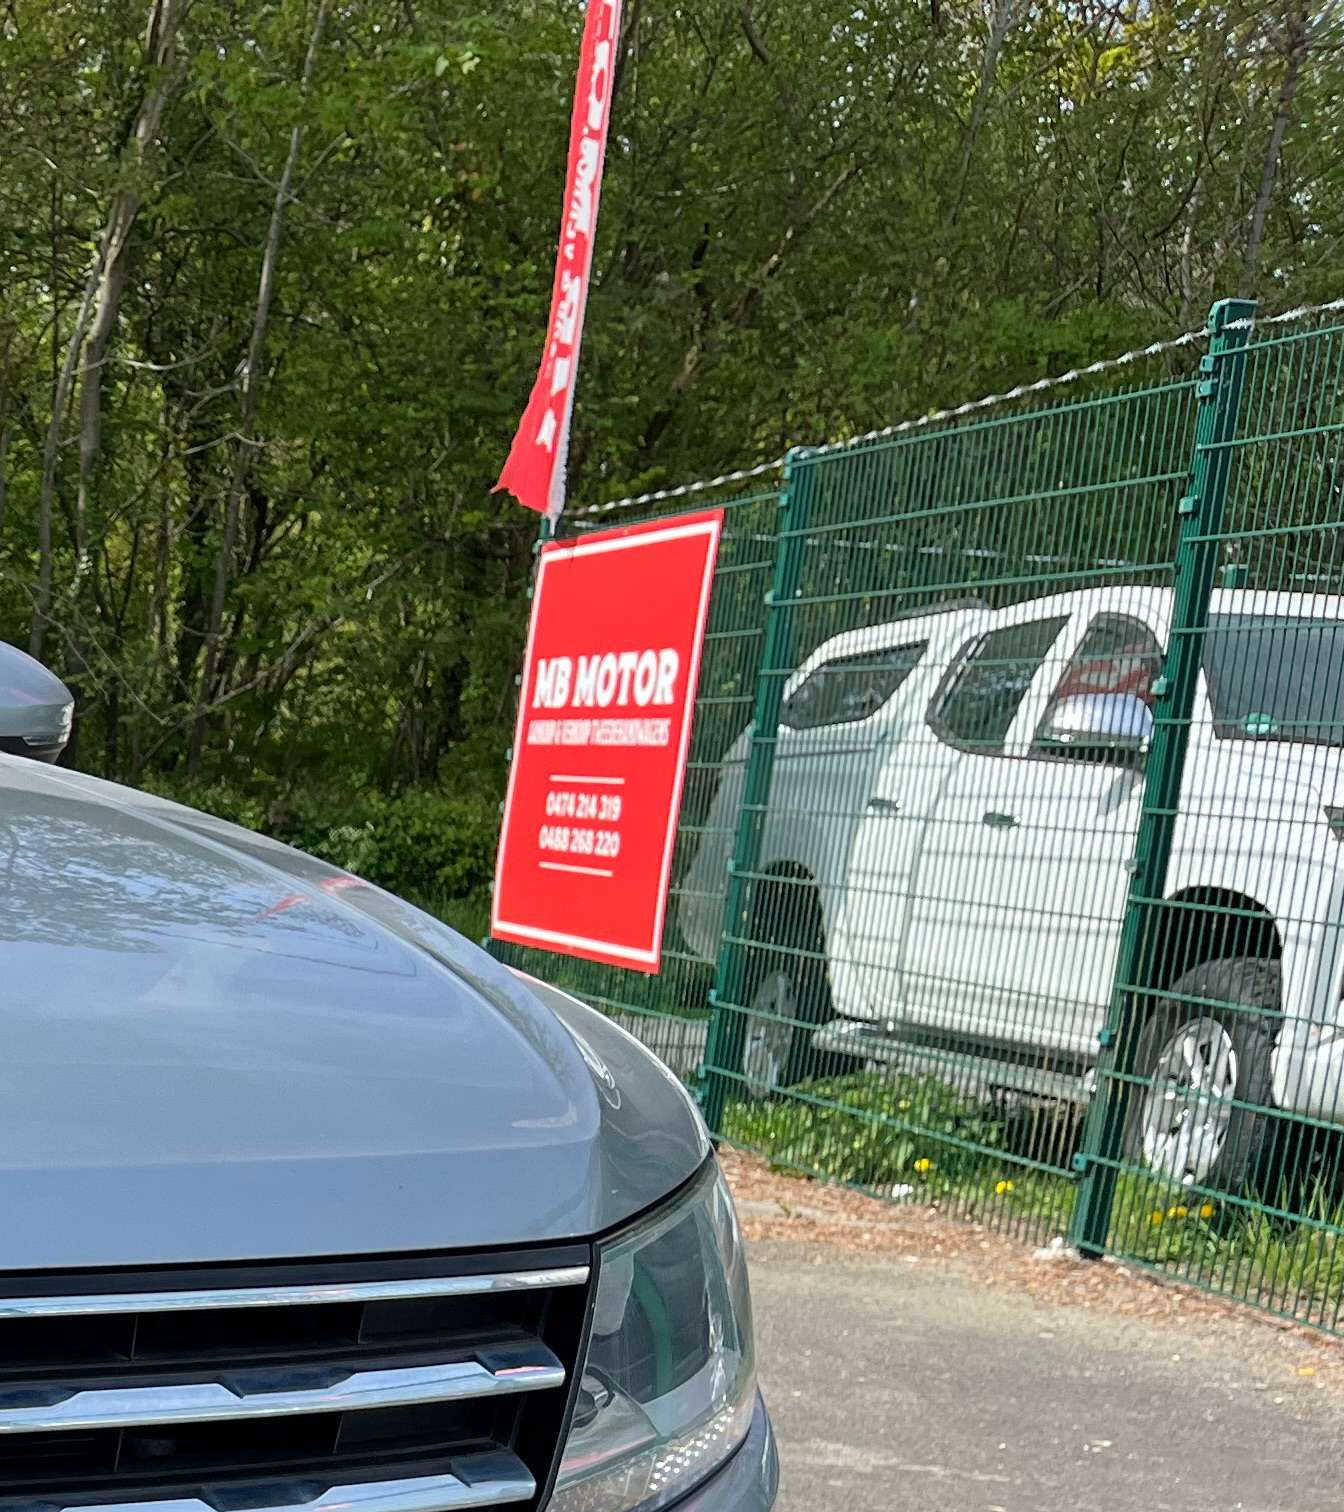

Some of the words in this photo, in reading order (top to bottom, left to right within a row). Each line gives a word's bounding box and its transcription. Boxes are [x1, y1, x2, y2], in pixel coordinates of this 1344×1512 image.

[532, 656, 572, 709] MB
[571, 648, 679, 708] MOTOR
[594, 829, 621, 858] 220
